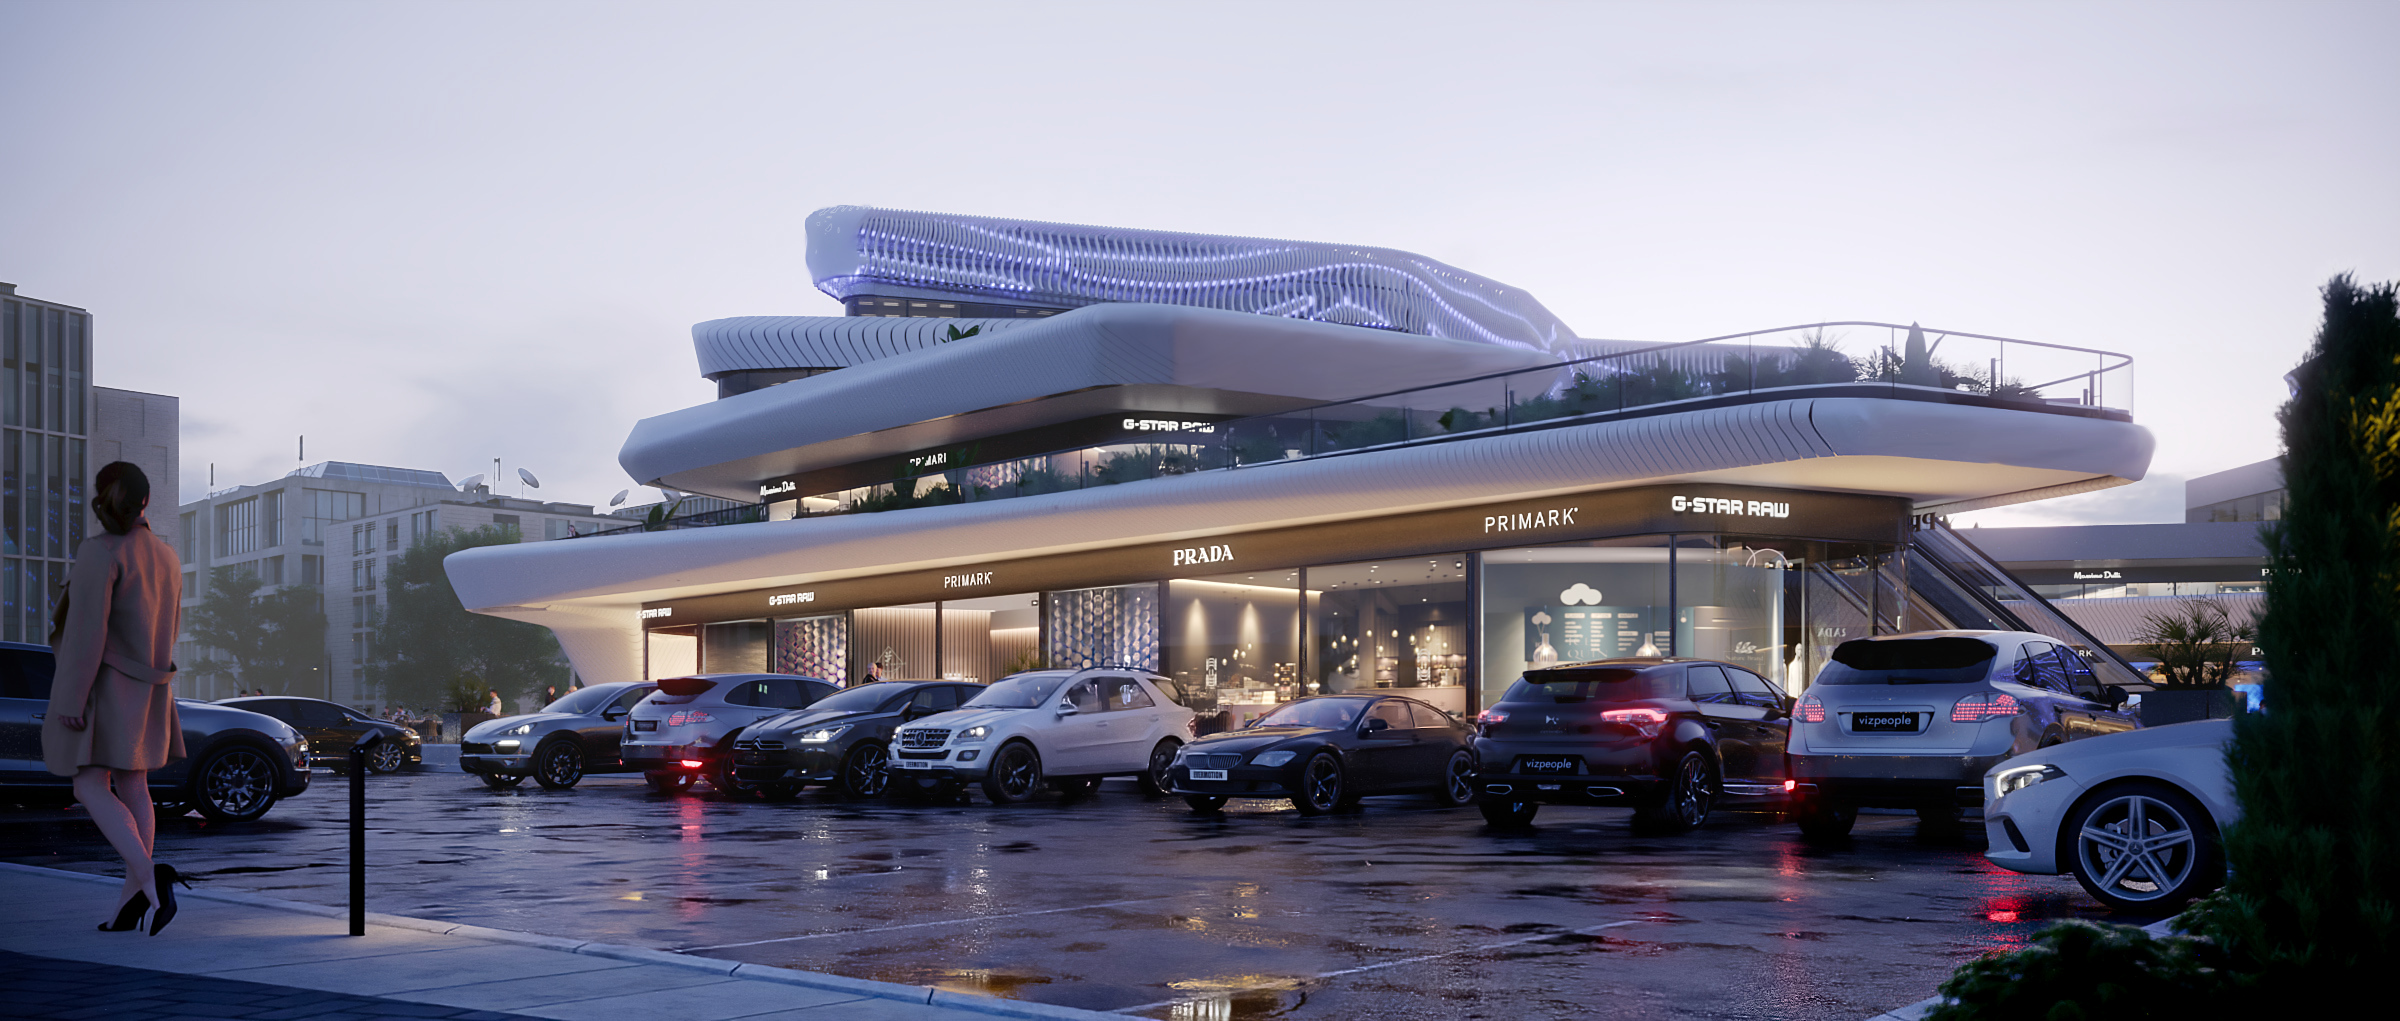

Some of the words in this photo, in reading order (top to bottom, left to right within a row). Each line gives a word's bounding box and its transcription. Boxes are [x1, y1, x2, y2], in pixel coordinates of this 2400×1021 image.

[1123, 418, 1179, 431] G-STAR
[1671, 495, 1744, 516] G-STAR
[1747, 500, 1790, 518] RAW
[1484, 506, 1579, 534] PRIMARK
[1173, 544, 1235, 567] PRADA
[944, 571, 993, 589] PRIMARK
[2073, 571, 2103, 580] Massimo
[769, 594, 797, 606] G-STAR
[796, 591, 815, 604] RAW
[657, 607, 672, 618] RAW
[1859, 714, 1911, 728] vizpeople
[1526, 758, 1572, 771] vizpeople
